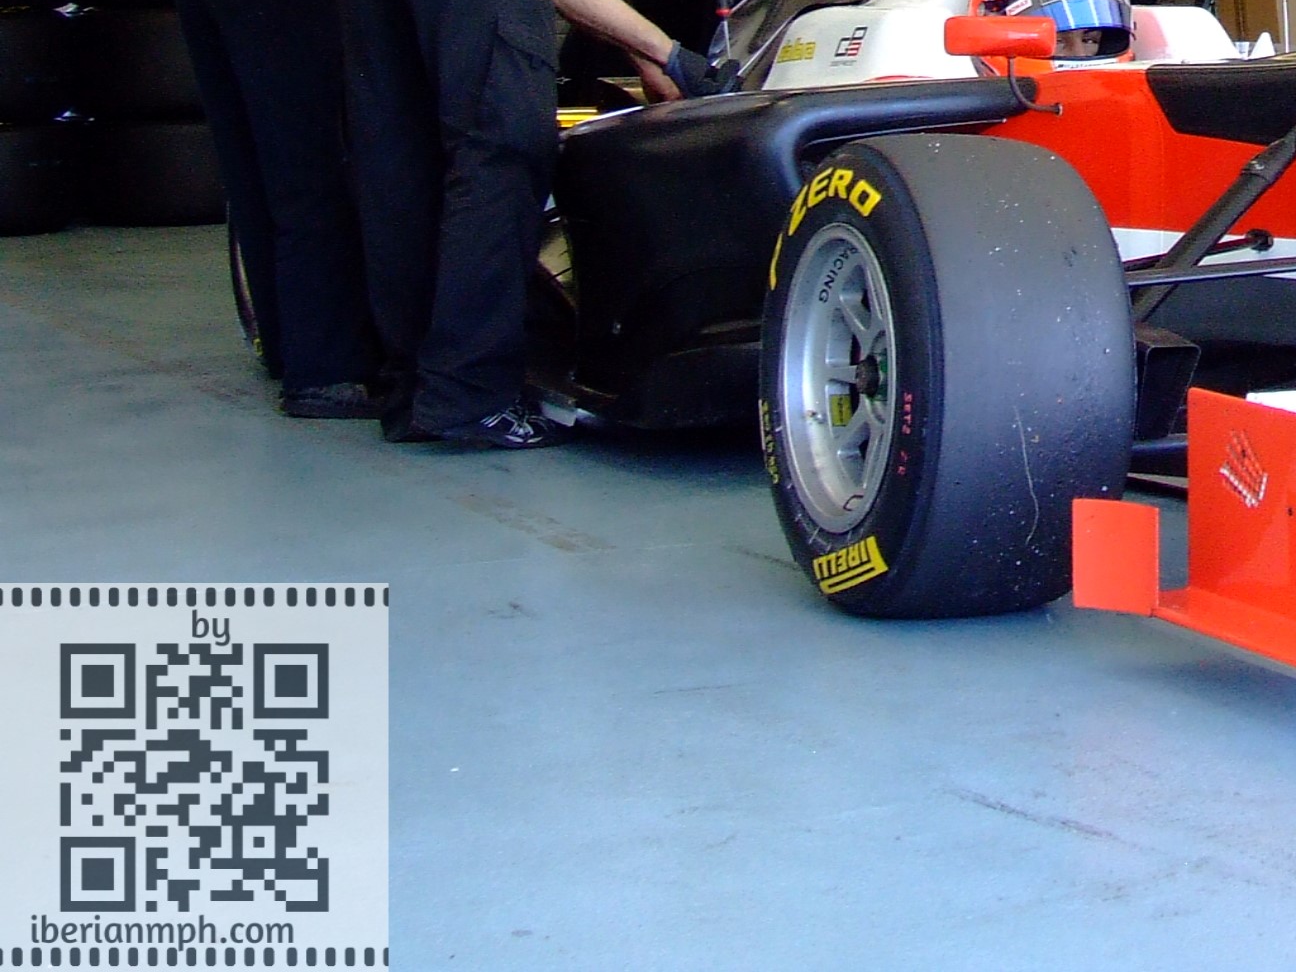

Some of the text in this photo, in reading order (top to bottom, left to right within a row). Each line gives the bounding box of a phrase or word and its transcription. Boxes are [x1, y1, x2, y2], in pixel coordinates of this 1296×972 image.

[788, 167, 882, 236] ZERO
[818, 247, 859, 303] RACING
[812, 535, 890, 595] PIRELLI
